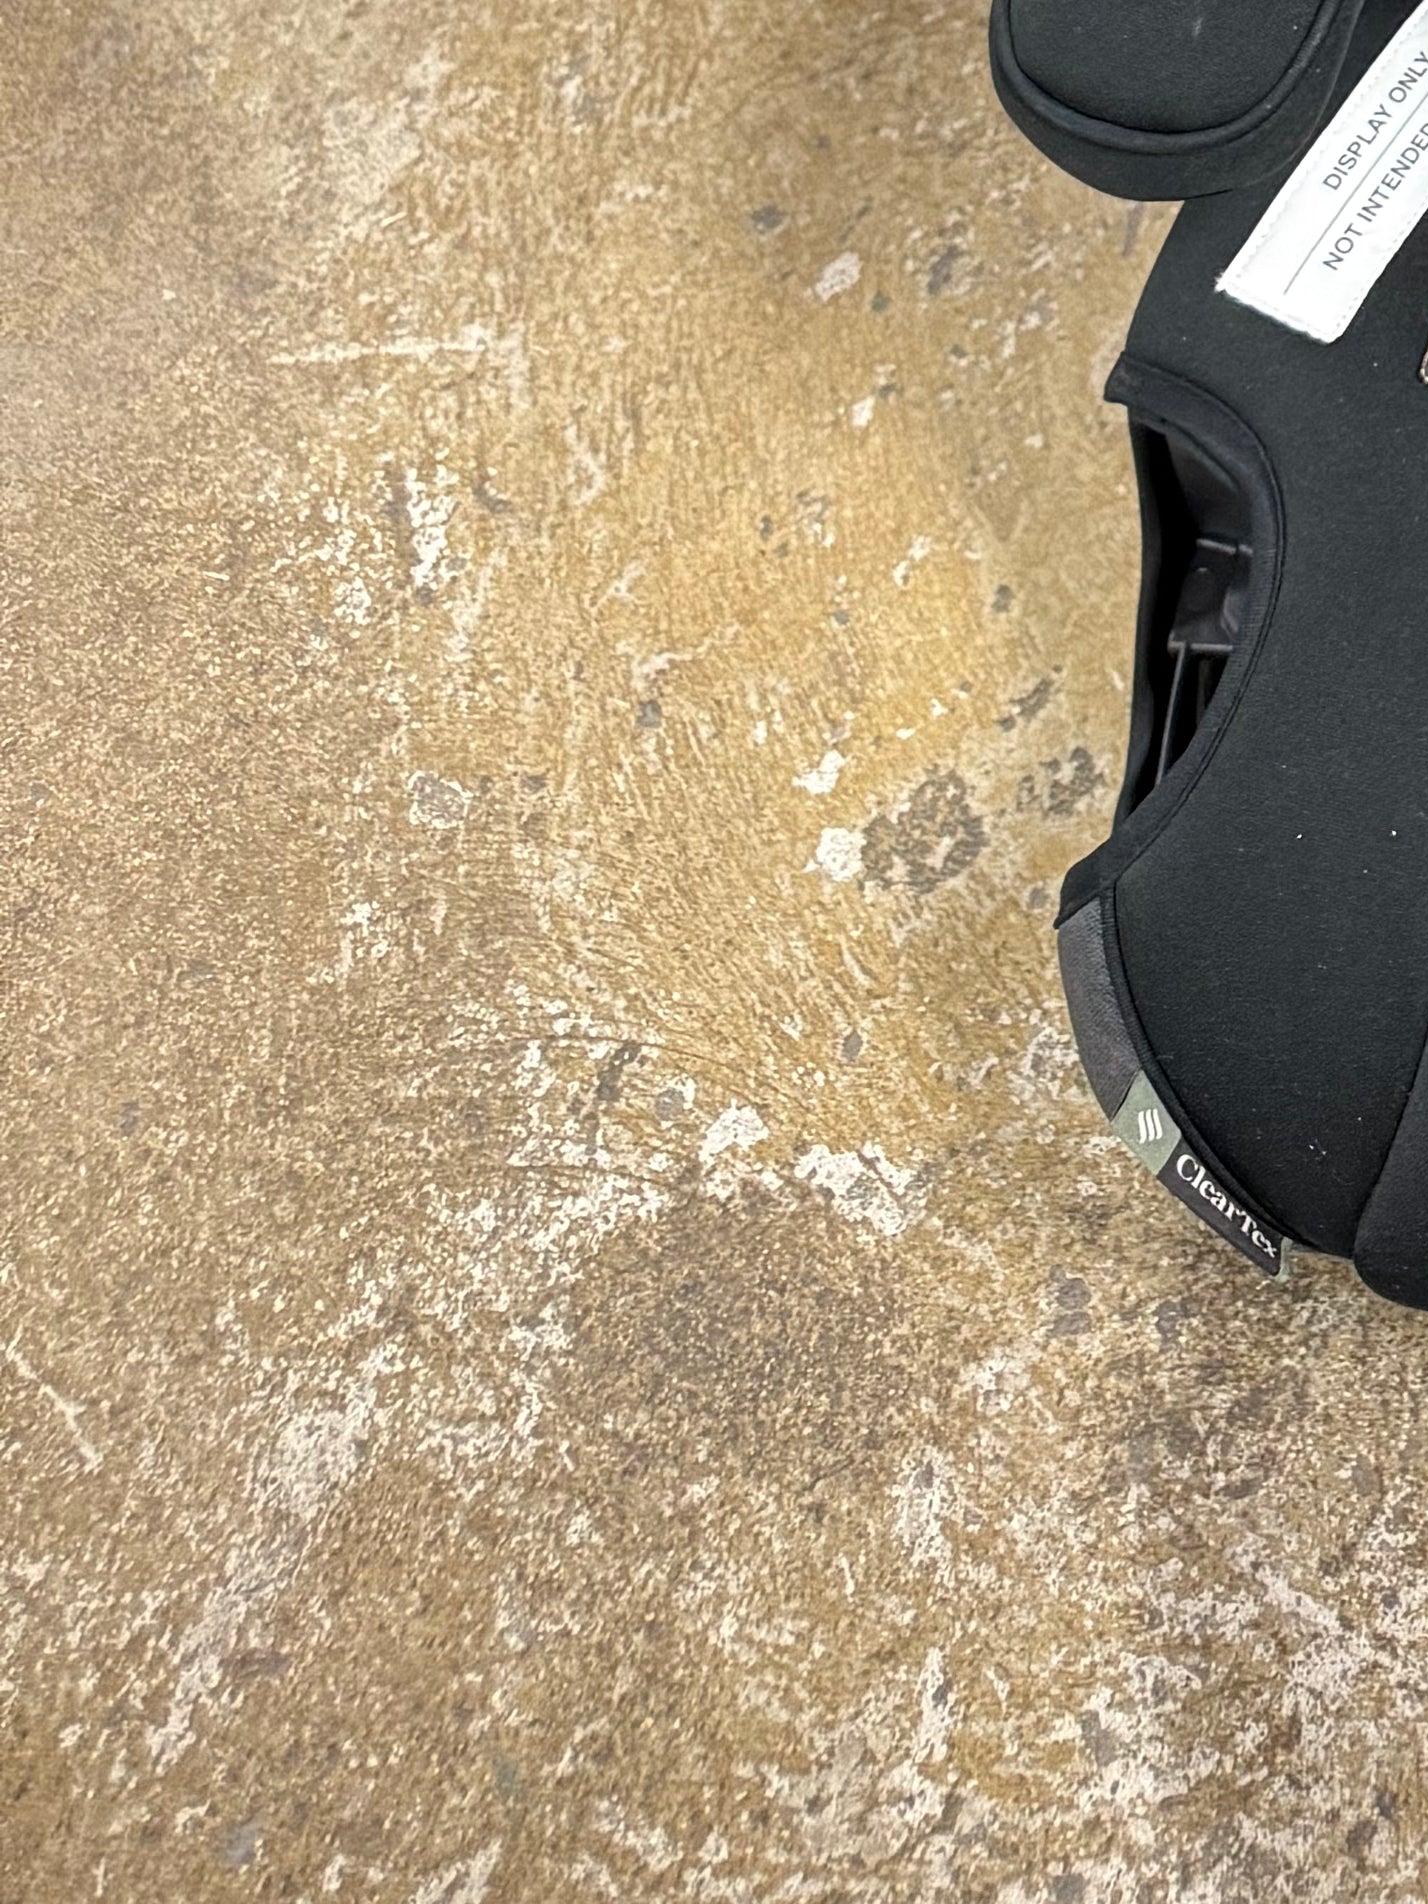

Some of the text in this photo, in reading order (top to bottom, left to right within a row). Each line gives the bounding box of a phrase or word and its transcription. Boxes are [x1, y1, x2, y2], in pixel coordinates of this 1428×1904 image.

[1322, 103, 1393, 191] DISPLAY
[1322, 223, 1363, 271] NOT
[1176, 1153, 1278, 1259] ClearTex
